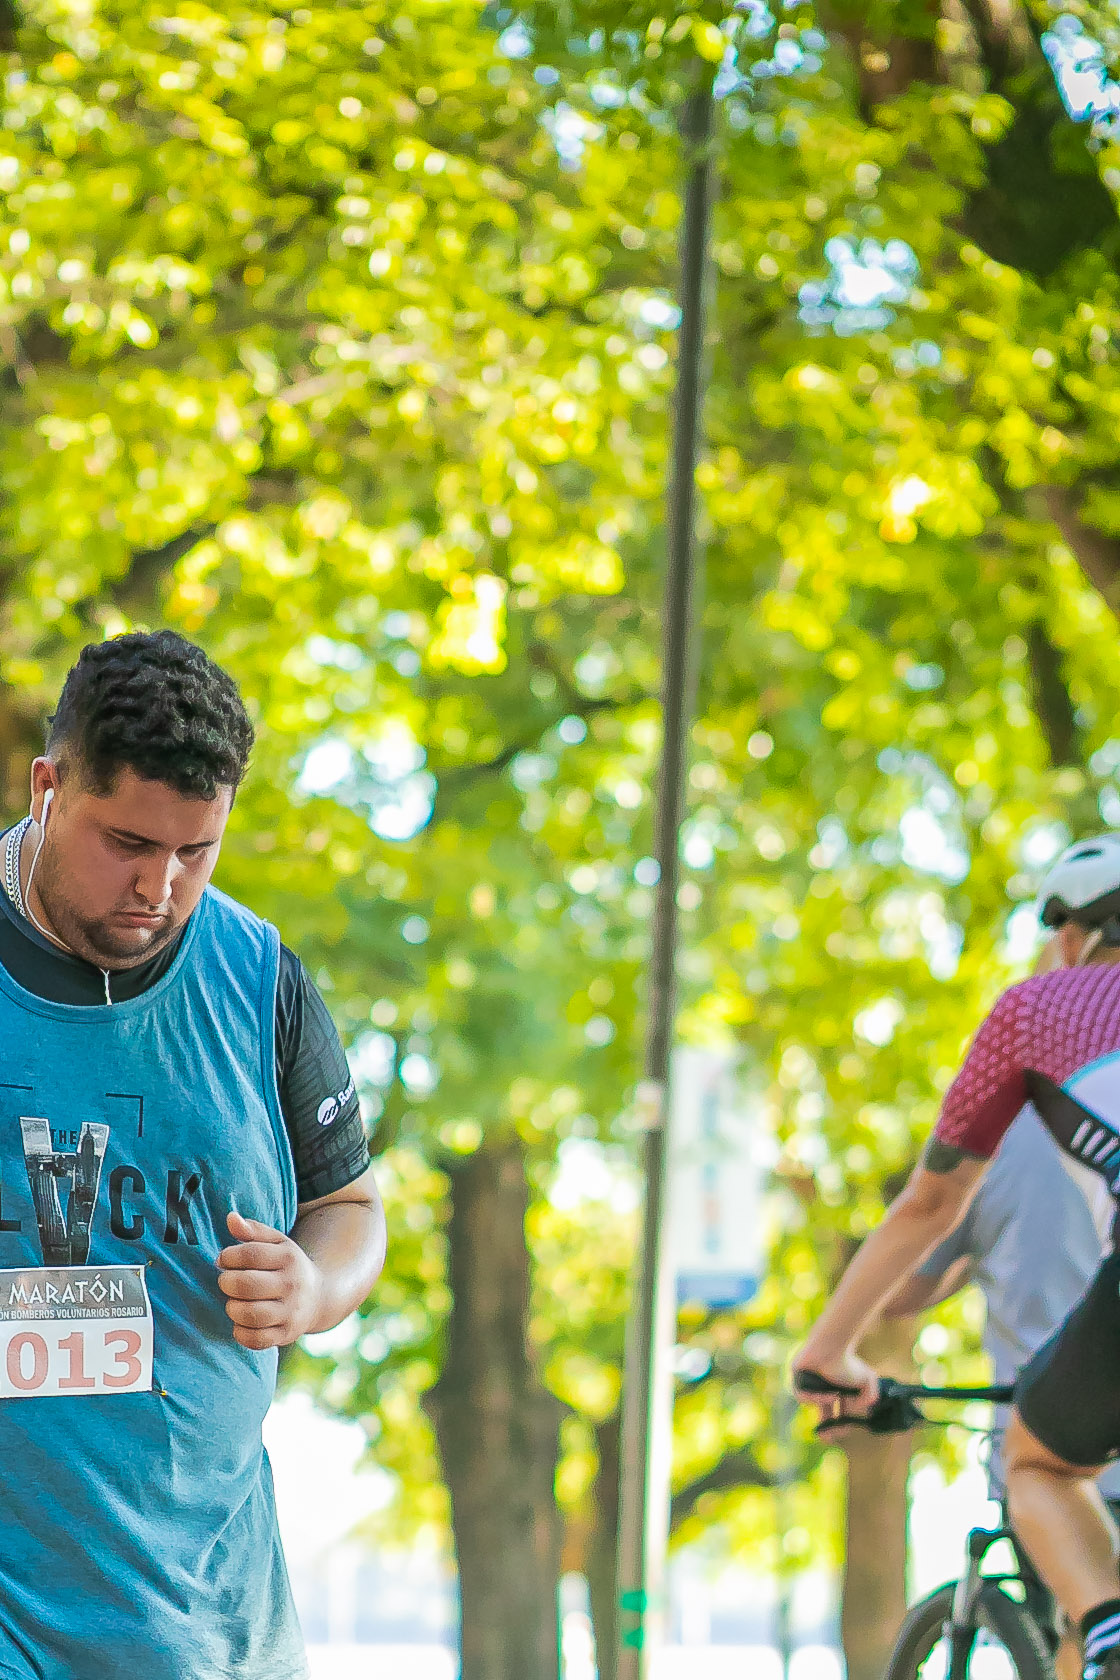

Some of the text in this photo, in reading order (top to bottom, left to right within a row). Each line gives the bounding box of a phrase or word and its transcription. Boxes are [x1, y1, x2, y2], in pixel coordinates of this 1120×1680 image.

[51, 1128, 78, 1145] THE
[8, 1273, 124, 1305] MARATÓN
[11, 1308, 55, 1320] BOMBEROS
[56, 1307, 110, 1319] VOLUNTARIOS
[111, 1306, 144, 1318] ROSARIO
